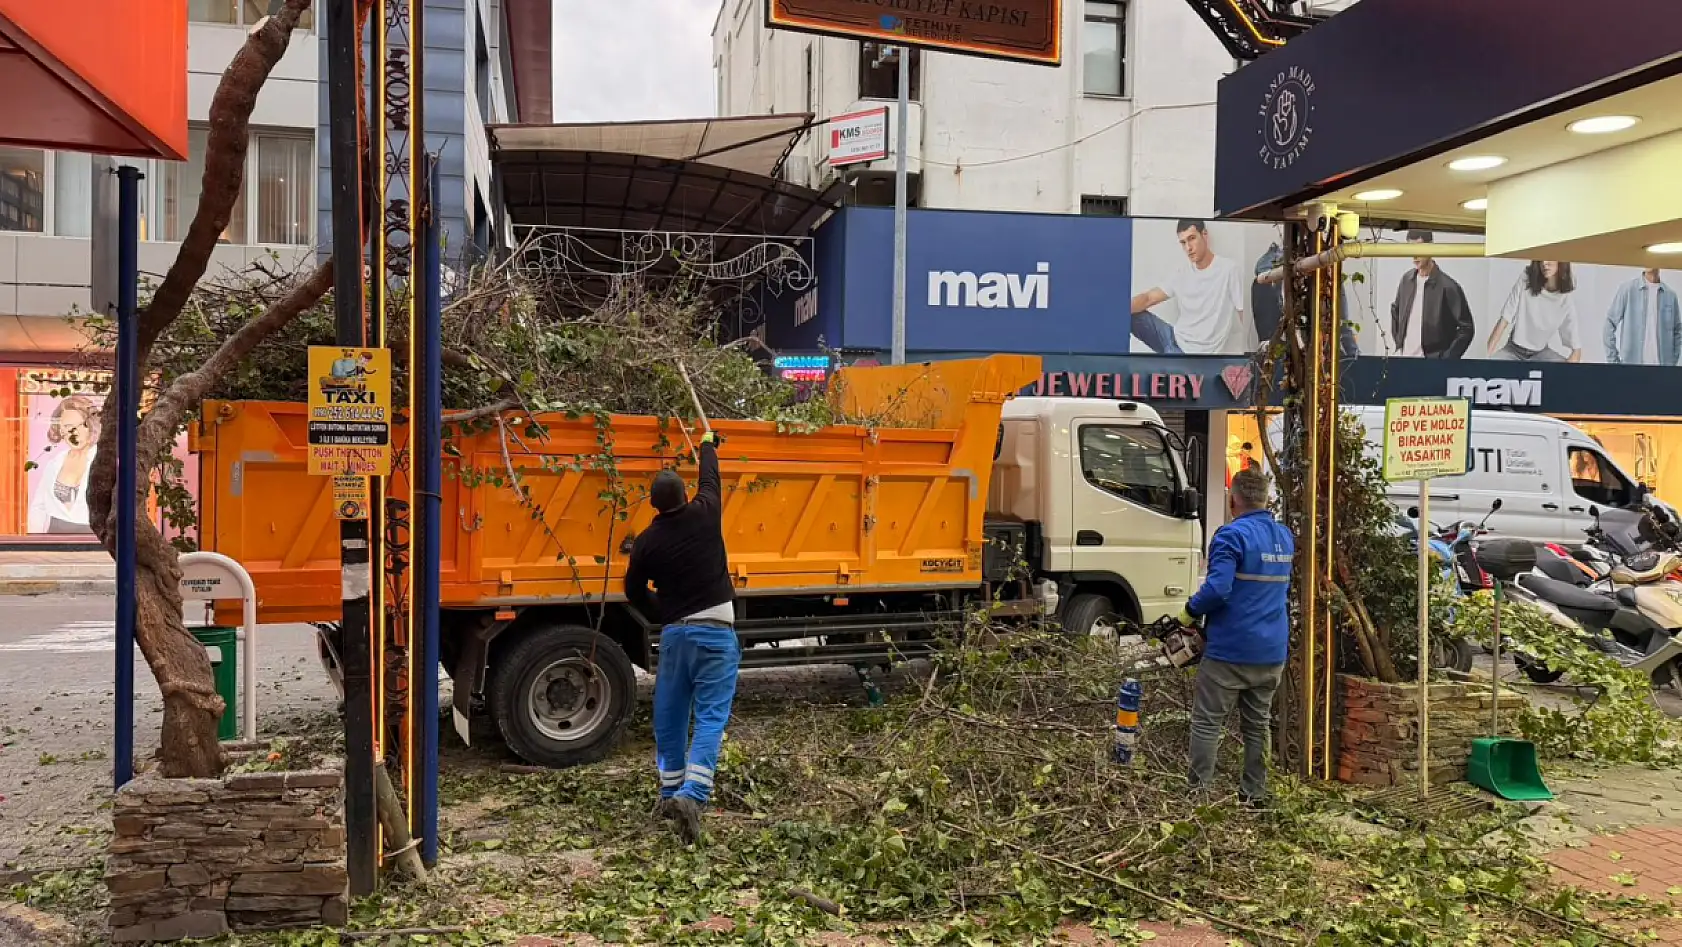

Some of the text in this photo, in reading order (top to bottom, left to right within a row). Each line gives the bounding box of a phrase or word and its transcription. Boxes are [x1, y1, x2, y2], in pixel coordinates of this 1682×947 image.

[1258, 65, 1316, 117] HAND MADE
[839, 126, 861, 140] KMS
[1259, 144, 1271, 165] EL
[927, 261, 1049, 309] mavi
[793, 275, 819, 328] mavi
[1032, 371, 1204, 399] JEWELLERY
[1446, 370, 1543, 407] mavi
[322, 390, 377, 404] TAXI
[1401, 403, 1454, 417] BU ALANA
[1390, 418, 1465, 436] ÇÖP VE MOLOZ
[1398, 433, 1454, 447] BIRAKMAK
[313, 447, 334, 458] PUSH
[1399, 448, 1451, 462] YASAKTIR
[320, 461, 340, 471] WAIT
